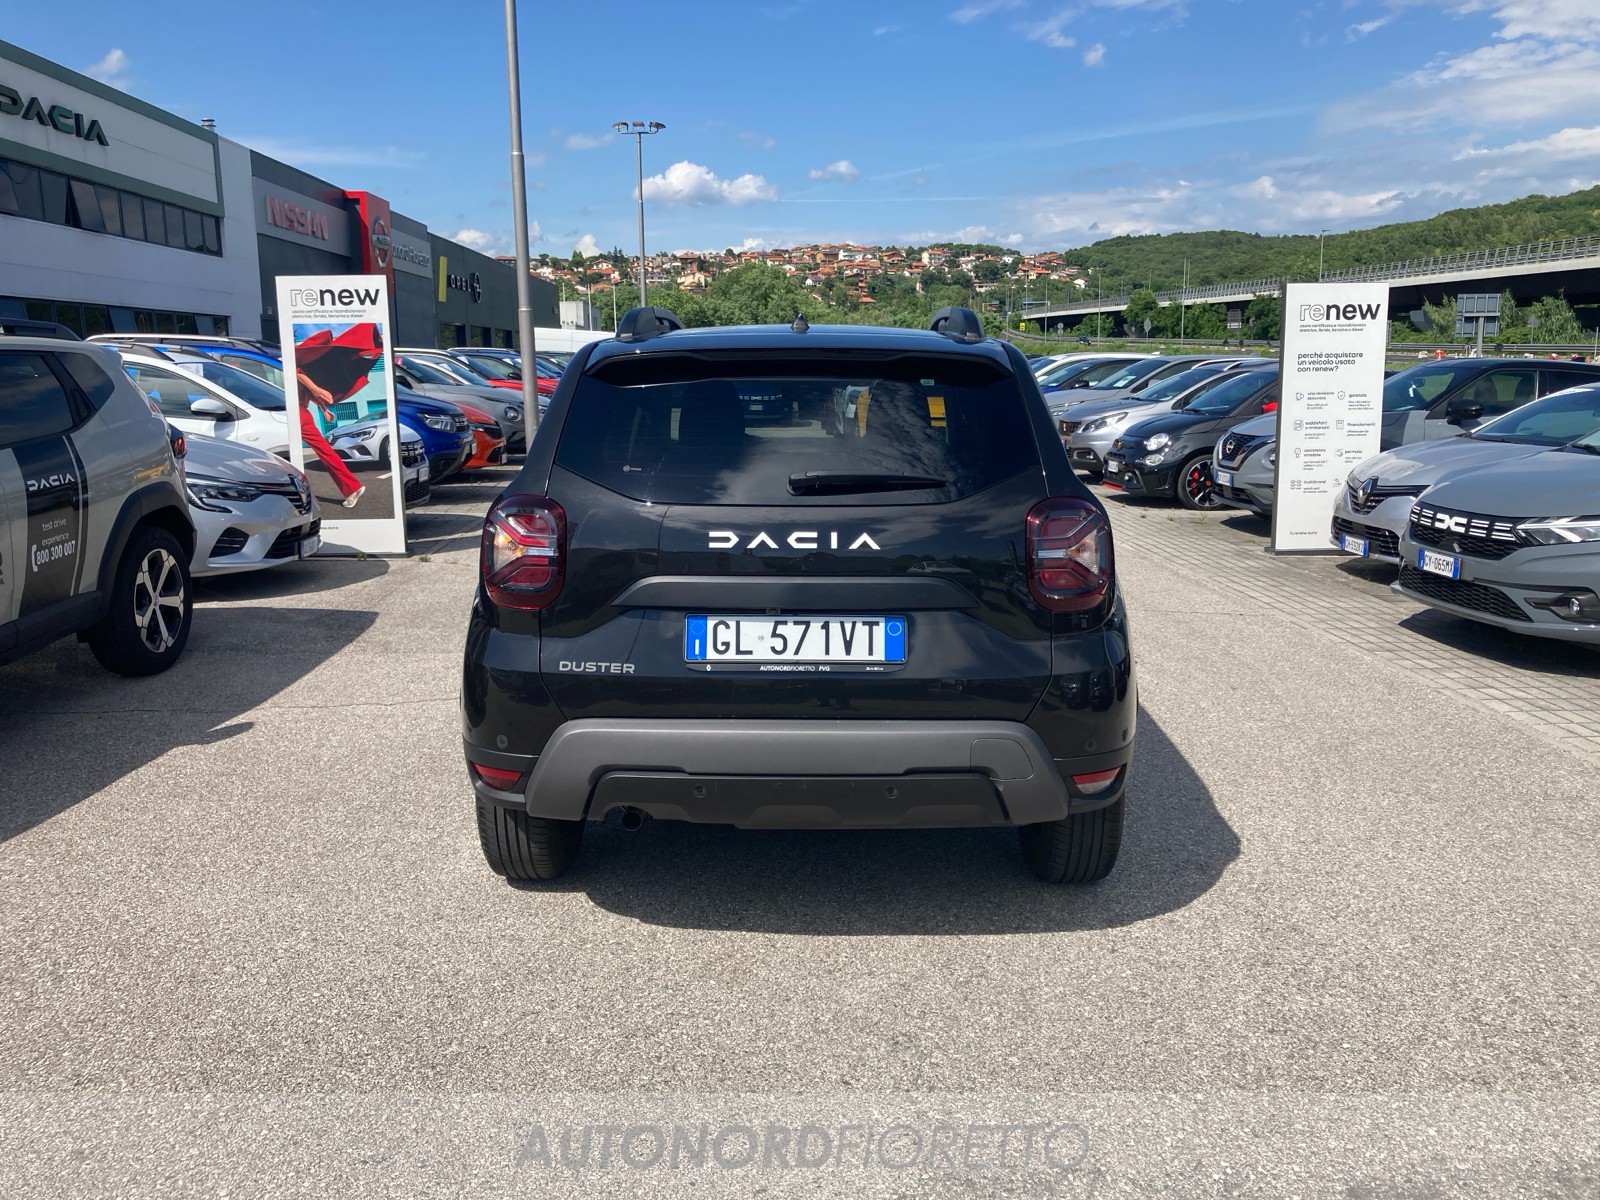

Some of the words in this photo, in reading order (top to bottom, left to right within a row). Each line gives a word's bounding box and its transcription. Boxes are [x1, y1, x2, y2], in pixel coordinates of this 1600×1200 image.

[0, 84, 109, 146] DACIA
[266, 195, 329, 241] NISSAN
[450, 274, 471, 292] OPEL
[290, 288, 380, 307] renew
[1300, 303, 1381, 321] renew
[1297, 352, 1323, 360] perché
[1324, 352, 1363, 360] acquistare
[27, 473, 75, 491] DACIA
[42, 521, 53, 531] test
[54, 518, 67, 528] drive
[42, 533, 70, 547] experience
[708, 531, 881, 550] DACIA
[37, 549, 50, 565] 800
[51, 545, 63, 561] 300
[64, 540, 76, 556] 007
[712, 620, 753, 656] GL
[770, 620, 880, 656] 571VT
[559, 661, 636, 676] DUSTER
